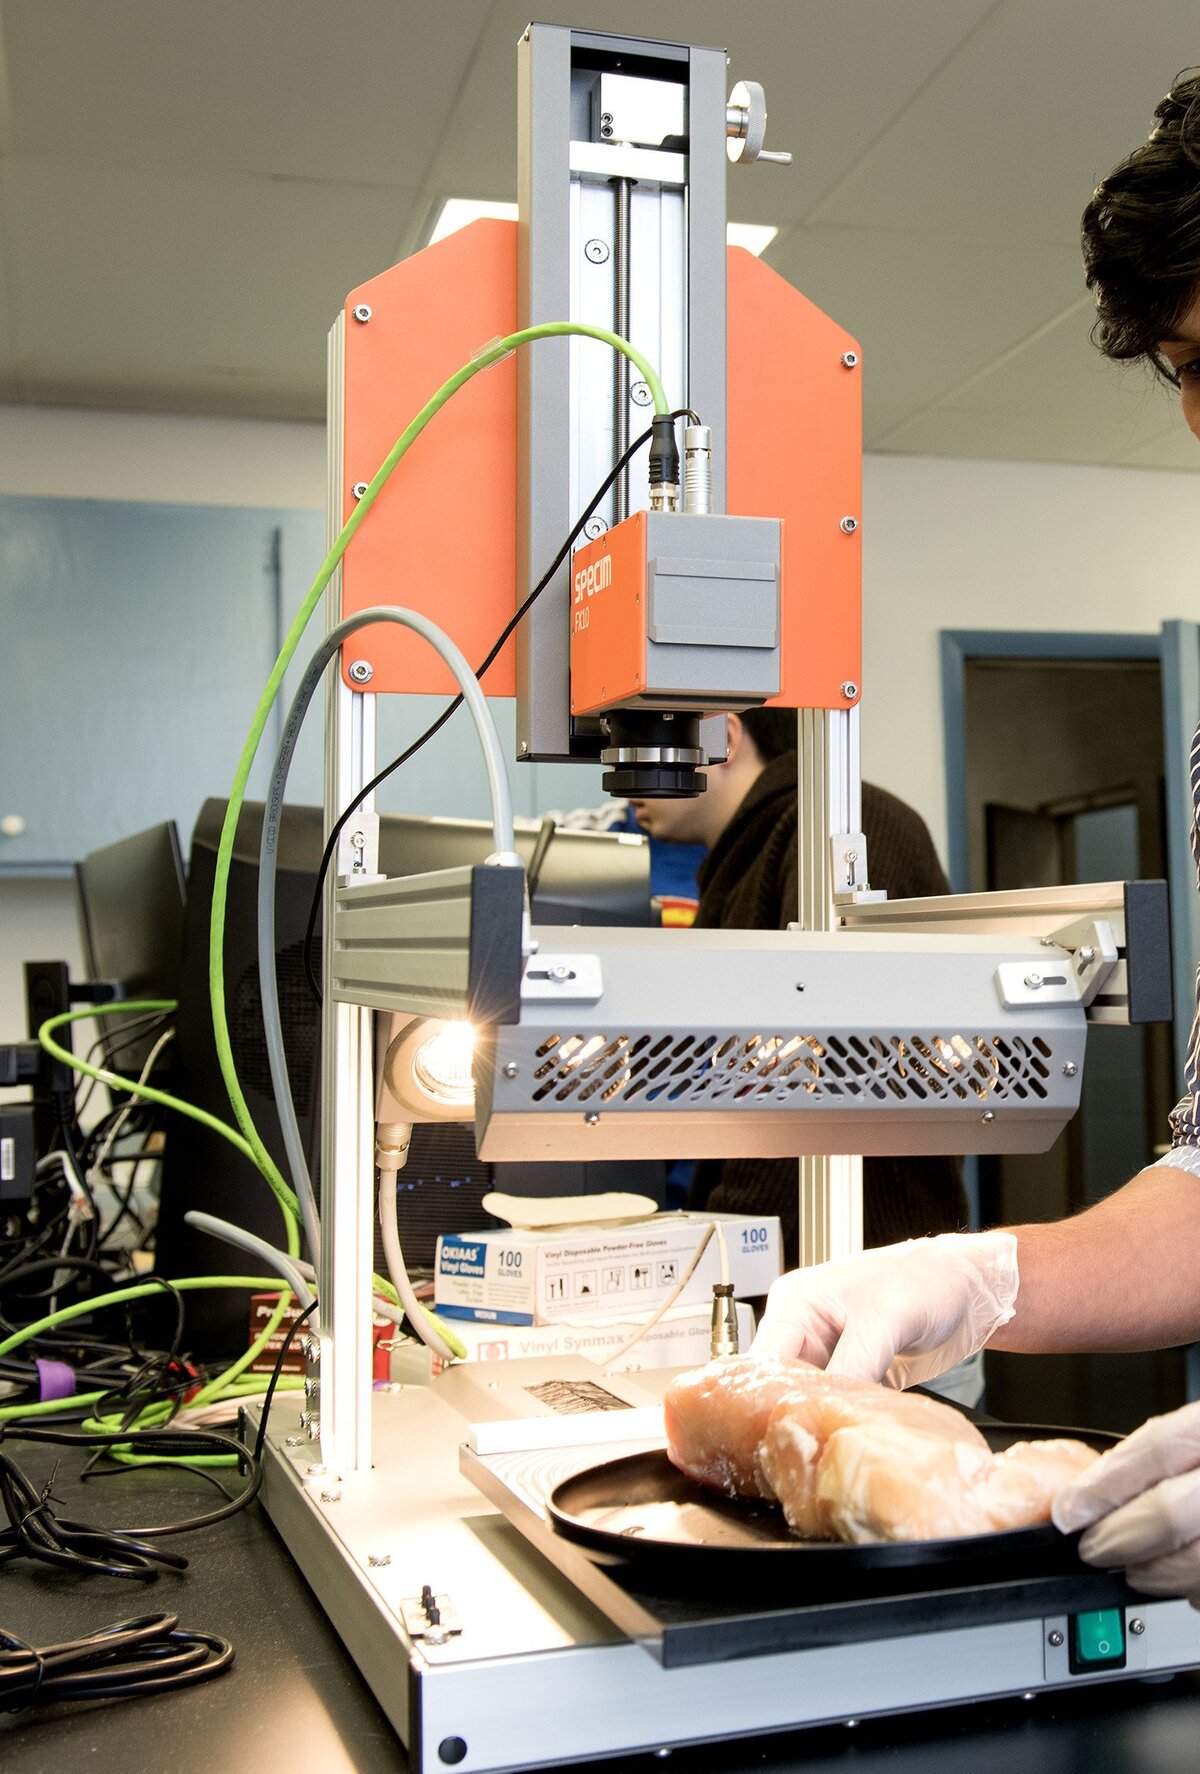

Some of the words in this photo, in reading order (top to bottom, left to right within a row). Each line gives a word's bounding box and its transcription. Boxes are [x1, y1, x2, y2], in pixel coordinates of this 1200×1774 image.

[574, 606, 590, 632] FX10
[741, 1228, 768, 1244] 100
[544, 1250, 562, 1260] Vinyl
[563, 1246, 601, 1258] Disposable
[646, 1239, 667, 1248] Gloves
[741, 1244, 769, 1253] GLOVES
[498, 1250, 523, 1268] 100
[440, 1261, 460, 1274] Vinyl
[460, 1262, 485, 1275] Gloves
[497, 1268, 523, 1278] GLOVES
[520, 1339, 559, 1355] Vinyl
[563, 1333, 625, 1352] Synmax
